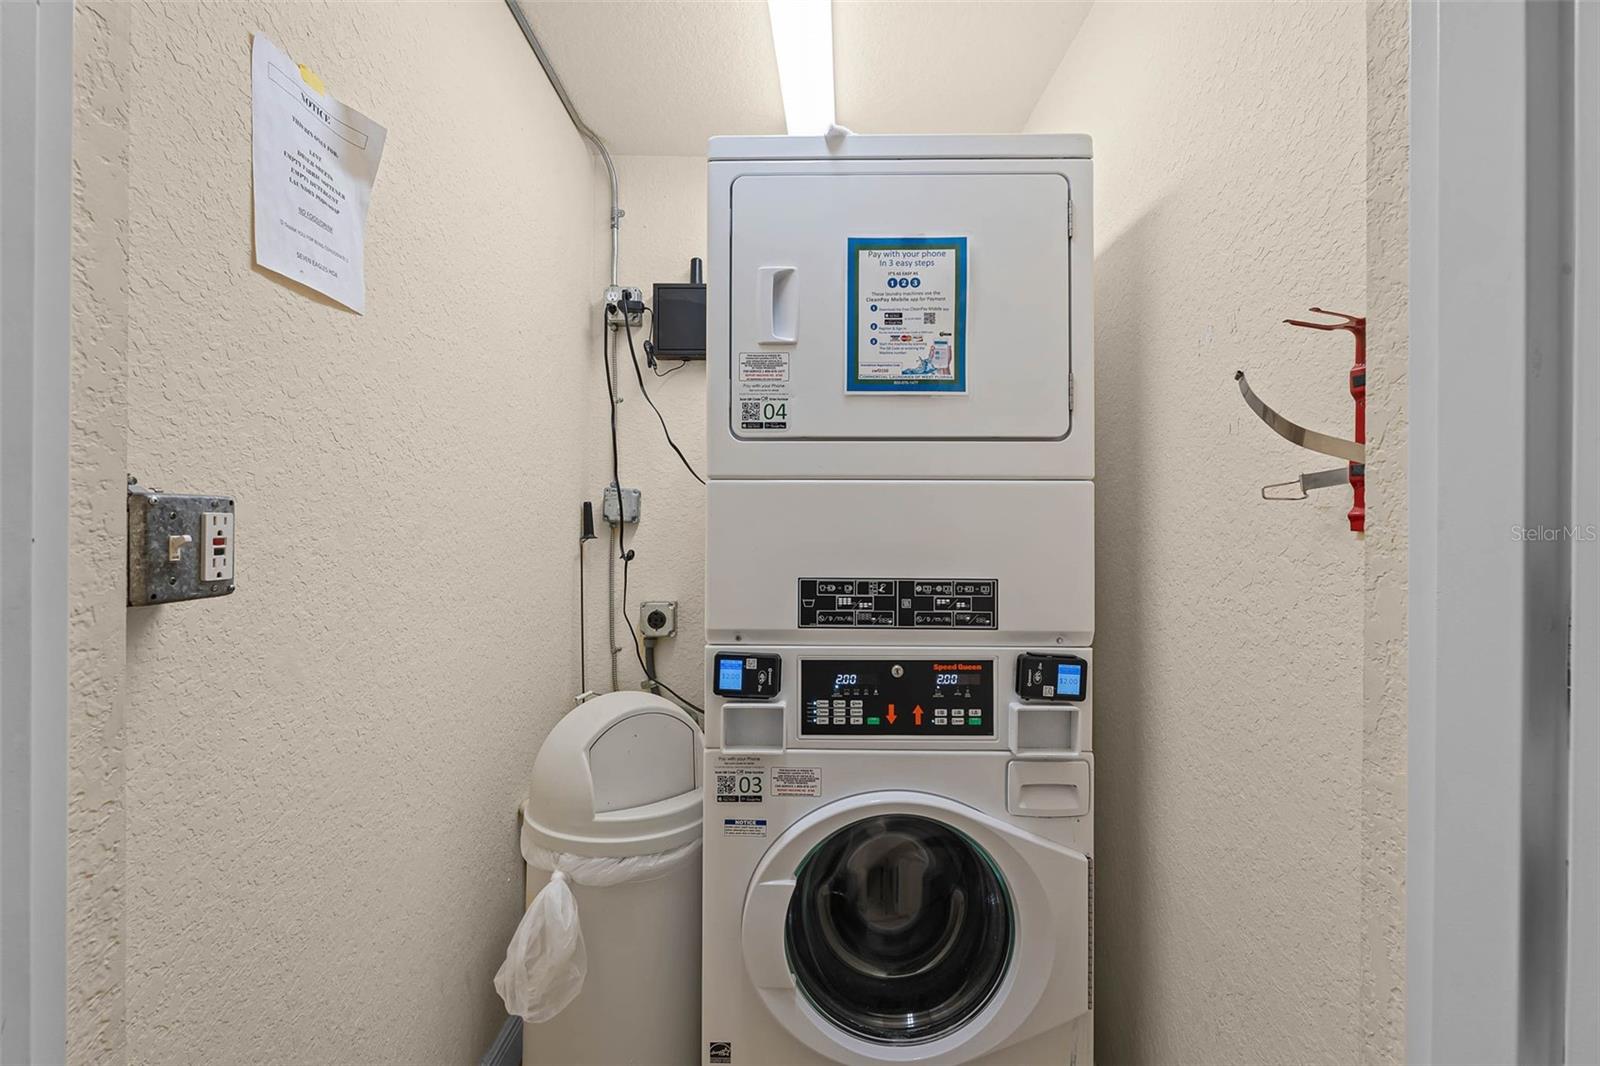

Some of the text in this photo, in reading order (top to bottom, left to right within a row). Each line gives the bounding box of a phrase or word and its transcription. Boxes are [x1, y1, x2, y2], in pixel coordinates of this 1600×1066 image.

[301, 92, 330, 124] NOTICE
[868, 250, 880, 258] Pay
[764, 403, 787, 420] 04
[739, 777, 762, 793] 03
